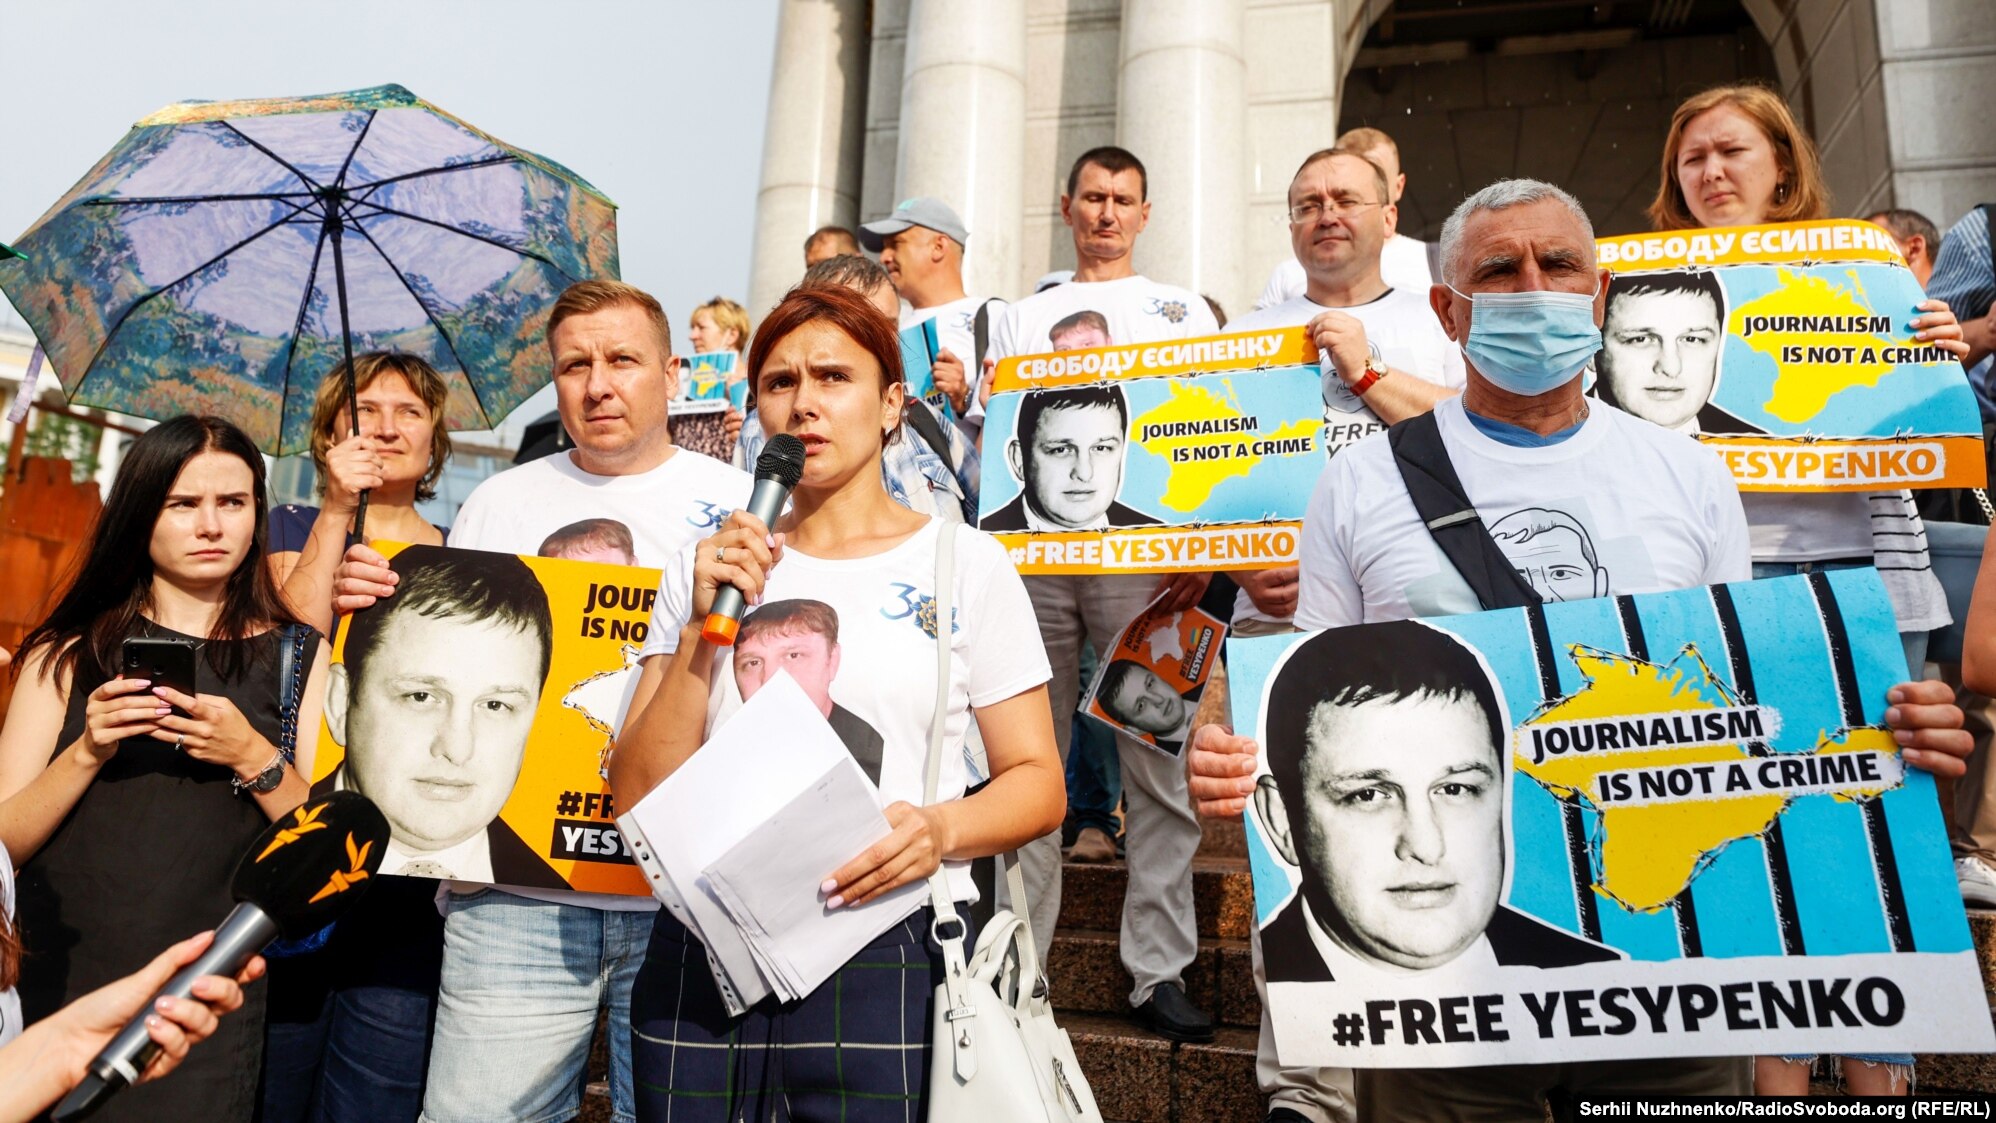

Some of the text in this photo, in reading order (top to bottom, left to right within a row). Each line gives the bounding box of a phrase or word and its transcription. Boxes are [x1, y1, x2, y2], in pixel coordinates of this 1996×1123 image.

[1744, 316, 1891, 337] JOURNALISM
[1017, 334, 1284, 379] СВОБОДУ ЄСИПЕНКУ
[1783, 346, 1803, 363] IS
[1807, 346, 1856, 363] NOT
[1860, 348, 1877, 364] A
[1142, 416, 1258, 443] JOURNALISM
[1173, 447, 1191, 463] IS
[1193, 444, 1232, 461] NOT
[1235, 443, 1249, 457] A
[1251, 437, 1312, 456] CRIME
[1716, 448, 1937, 479] ESYPENKO
[1009, 532, 1296, 566] #FREE YESYPENKO
[581, 616, 605, 638] IS
[1188, 628, 1212, 680] YESYPENKO
[1532, 709, 1764, 764] JOURNALISM
[1599, 753, 1882, 801] IS NOT A CRIME
[1333, 977, 1905, 1047] #FREE YESYPENKO
